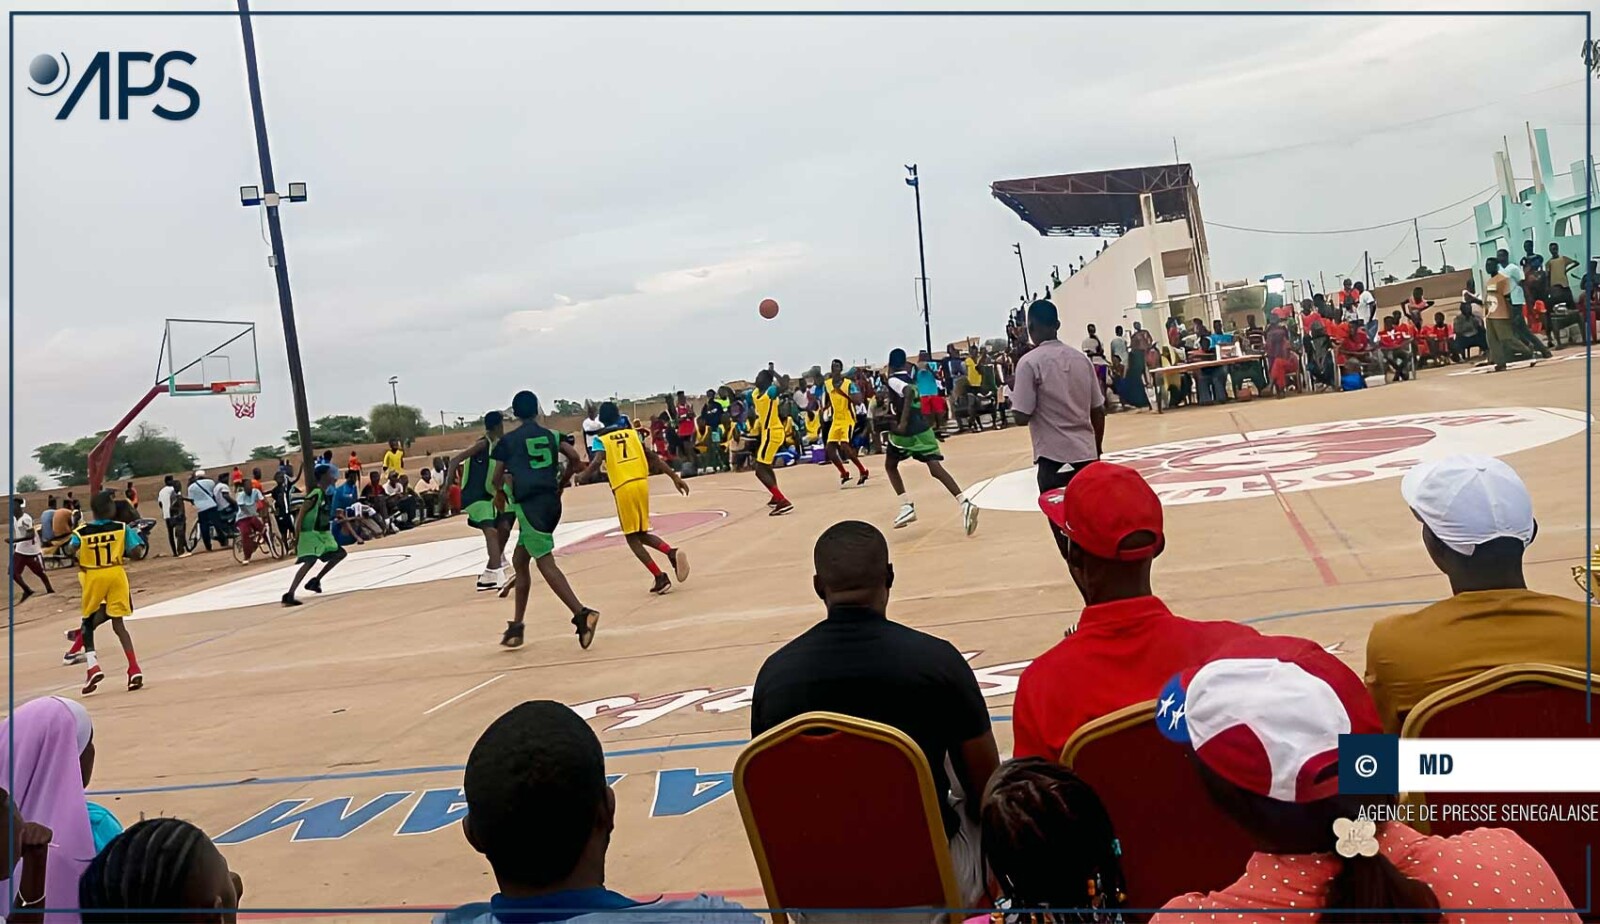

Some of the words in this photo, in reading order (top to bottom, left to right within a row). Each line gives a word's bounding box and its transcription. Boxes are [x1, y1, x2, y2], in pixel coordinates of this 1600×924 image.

[525, 435, 553, 470] 5
[616, 439, 629, 459] 7
[87, 542, 112, 567] 11
